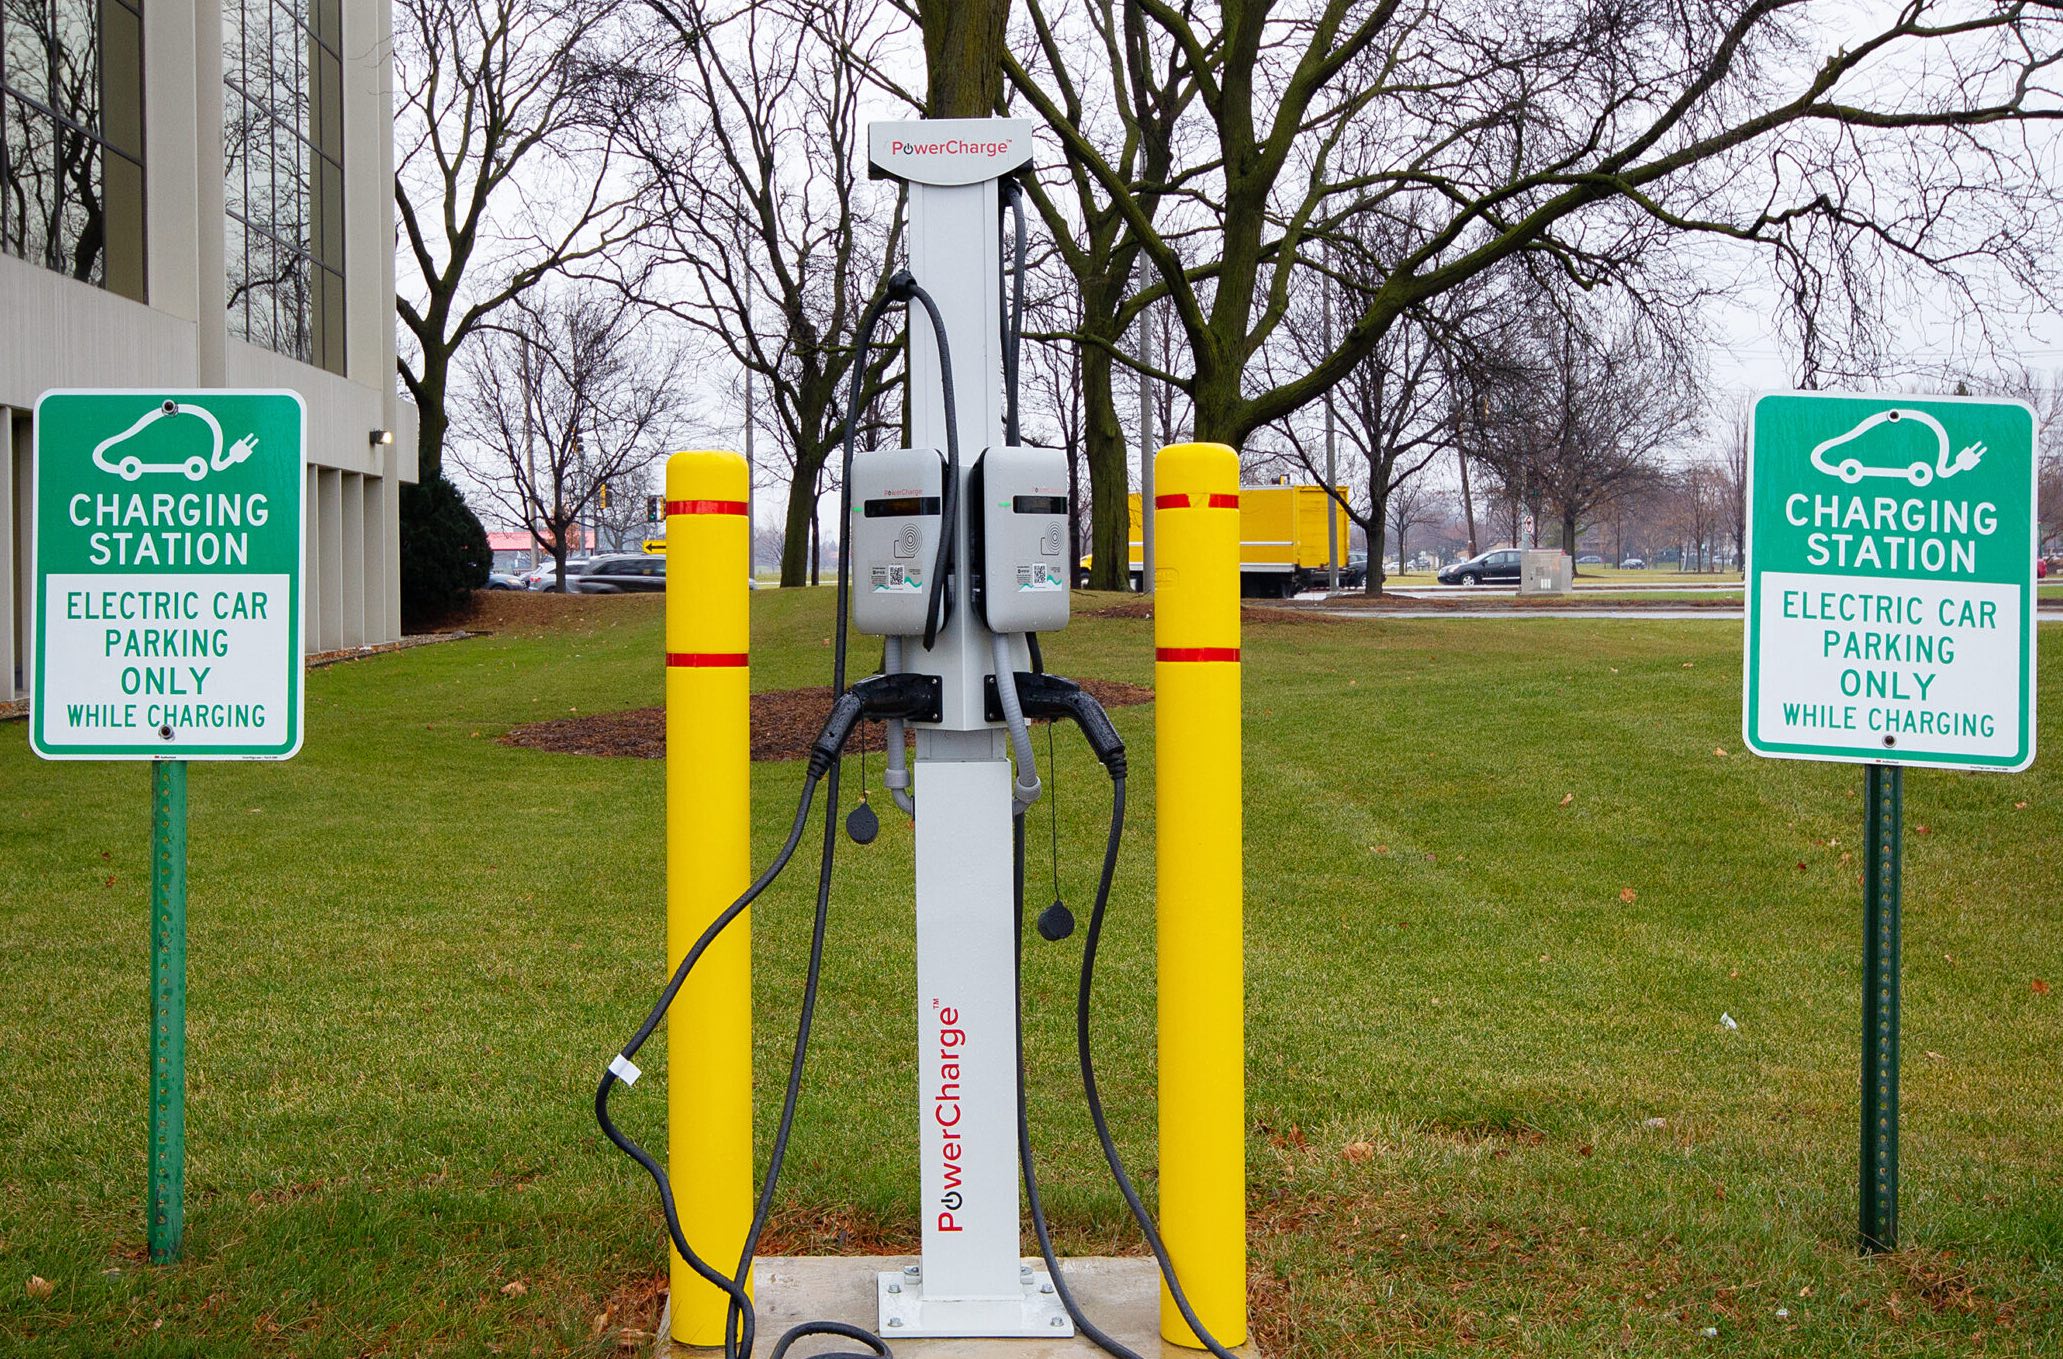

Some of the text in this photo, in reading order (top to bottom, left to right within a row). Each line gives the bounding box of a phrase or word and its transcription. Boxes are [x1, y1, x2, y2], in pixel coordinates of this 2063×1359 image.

[69, 493, 269, 527] CHARGING
[1785, 493, 1998, 536] CHARGING
[89, 532, 248, 566] STATION
[1806, 532, 1976, 574] STATION
[67, 591, 268, 620] ELECTRIC CAR
[1783, 590, 1997, 629] ELECTRIC CAR
[105, 629, 229, 657] PARKING
[1823, 630, 1955, 665] PARKING
[120, 666, 211, 695] ONLY
[1840, 668, 1937, 701] ONLY
[67, 704, 266, 728] WHILE CHARGING
[1783, 702, 1995, 738] WHILE CHARGING
